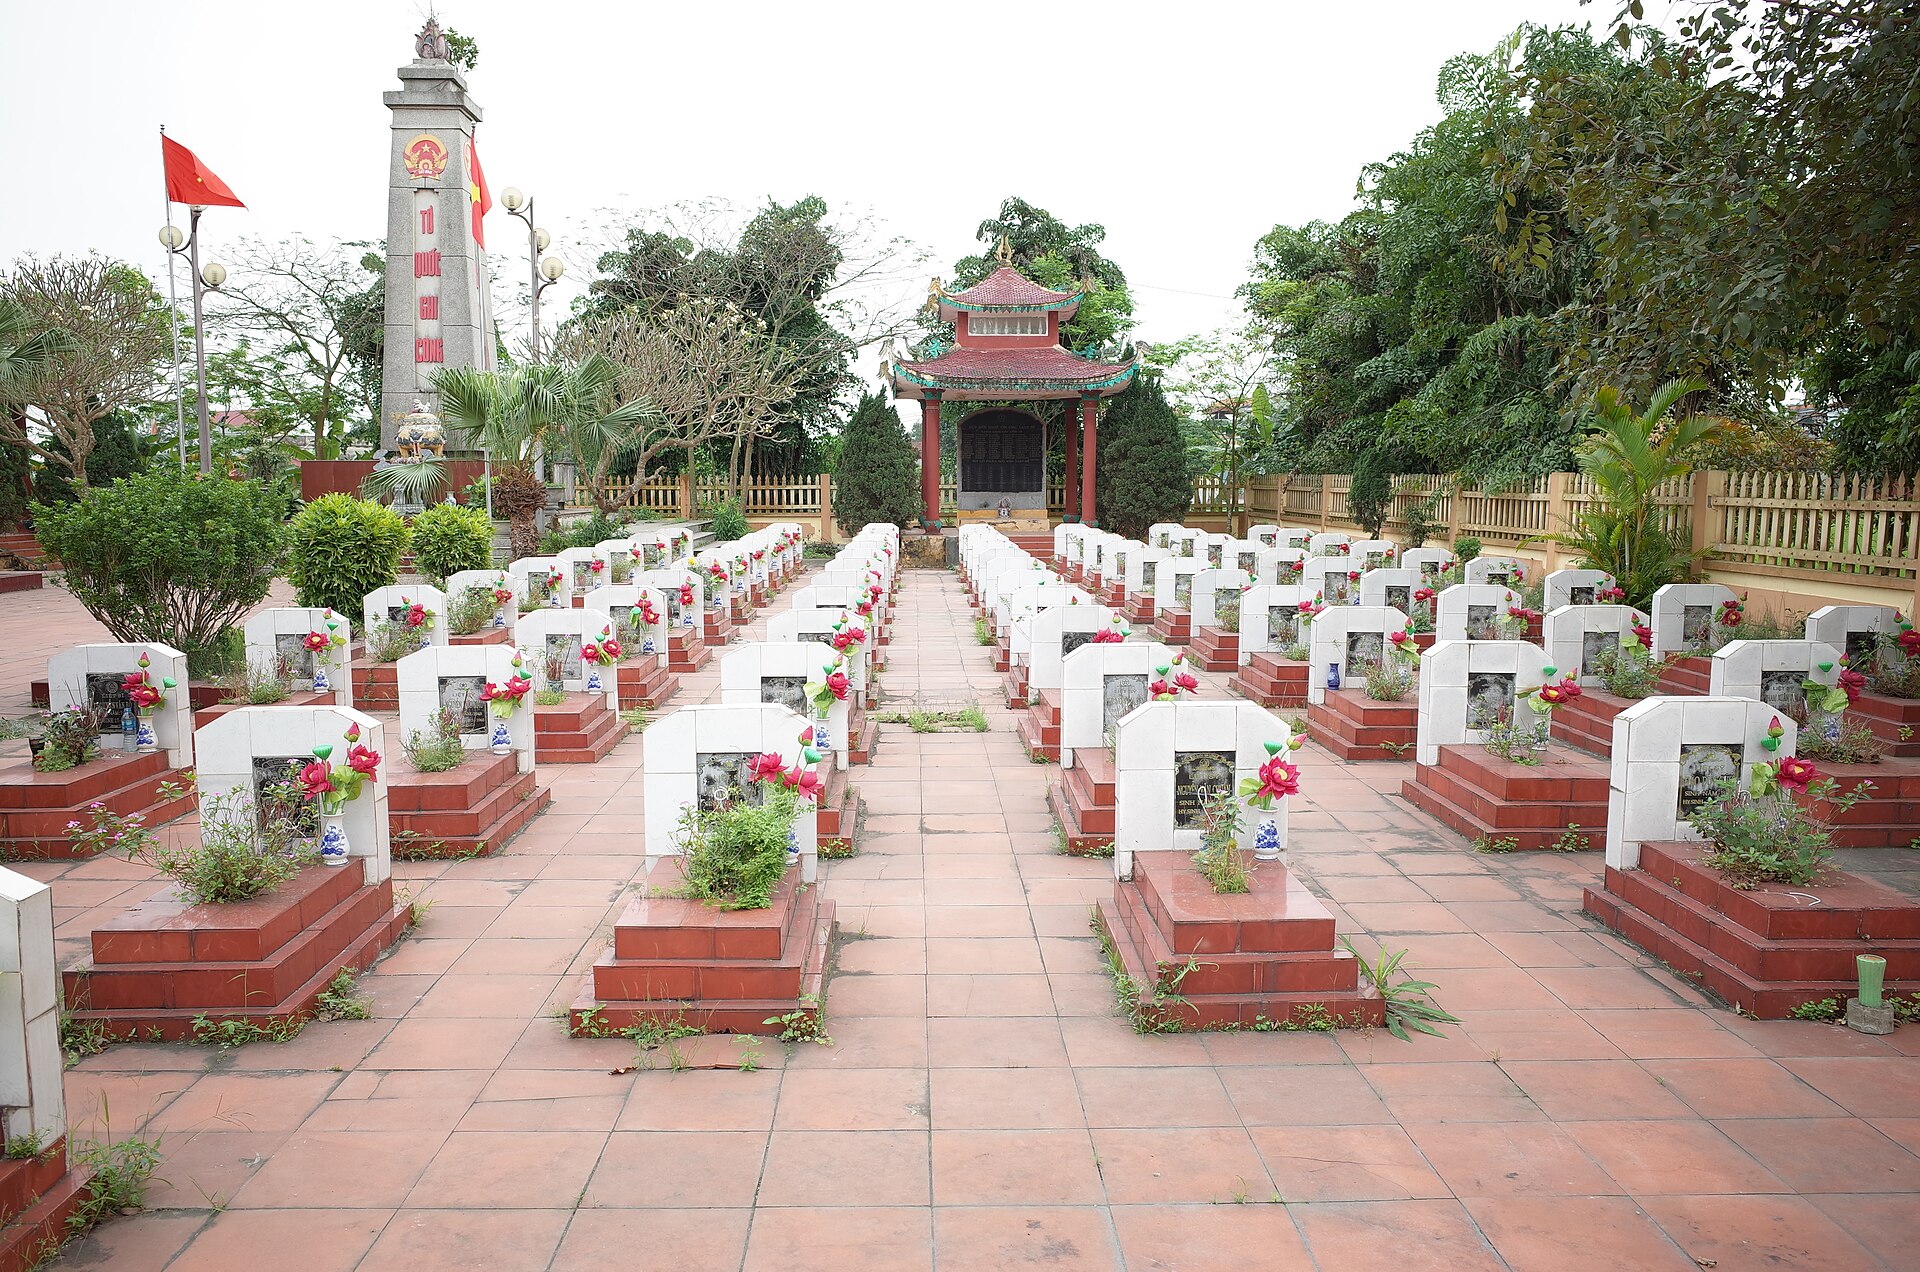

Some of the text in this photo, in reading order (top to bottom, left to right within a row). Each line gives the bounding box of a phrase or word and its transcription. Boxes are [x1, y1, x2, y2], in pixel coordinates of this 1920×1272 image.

[414, 248, 442, 278] QUỐC
[419, 296, 438, 320] GHI
[415, 337, 443, 363] CÔNG
